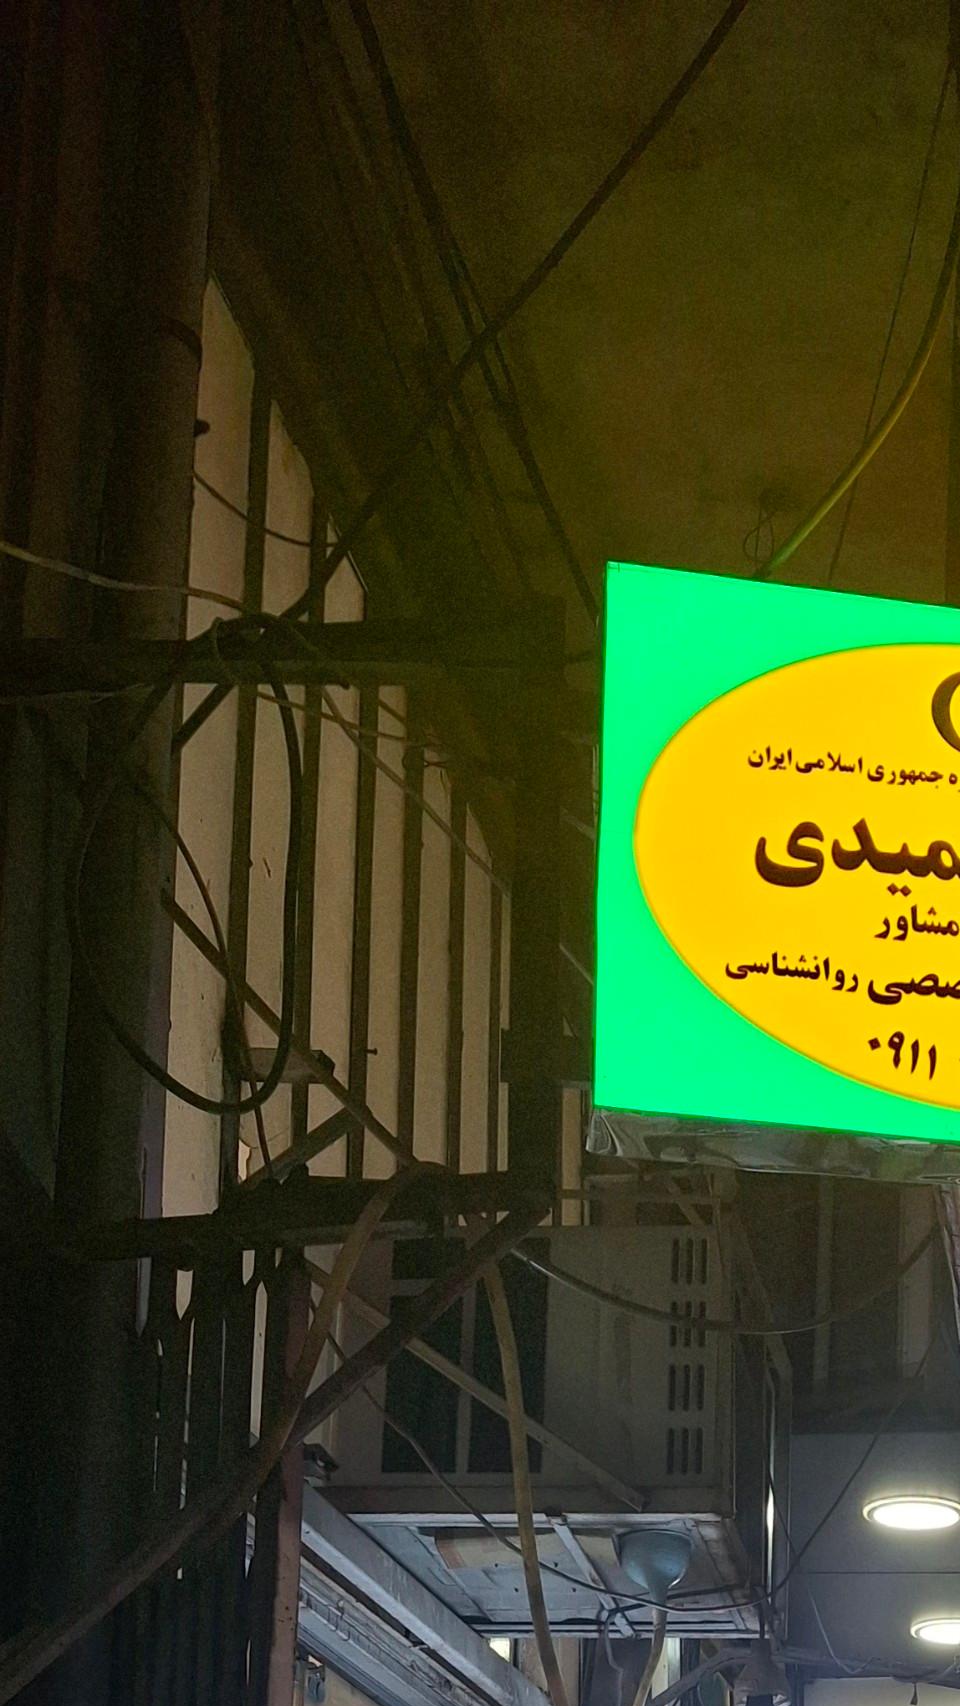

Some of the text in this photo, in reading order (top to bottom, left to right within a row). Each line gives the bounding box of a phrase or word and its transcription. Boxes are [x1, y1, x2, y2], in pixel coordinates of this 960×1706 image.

[747, 745, 793, 771] ایران
[795, 751, 863, 774] اسلامی
[866, 764, 944, 789] جمهوری
[874, 904, 960, 942] مشاور
[725, 951, 860, 993] روانشناسی
[867, 1030, 938, 1080] ۰۹۱۱
